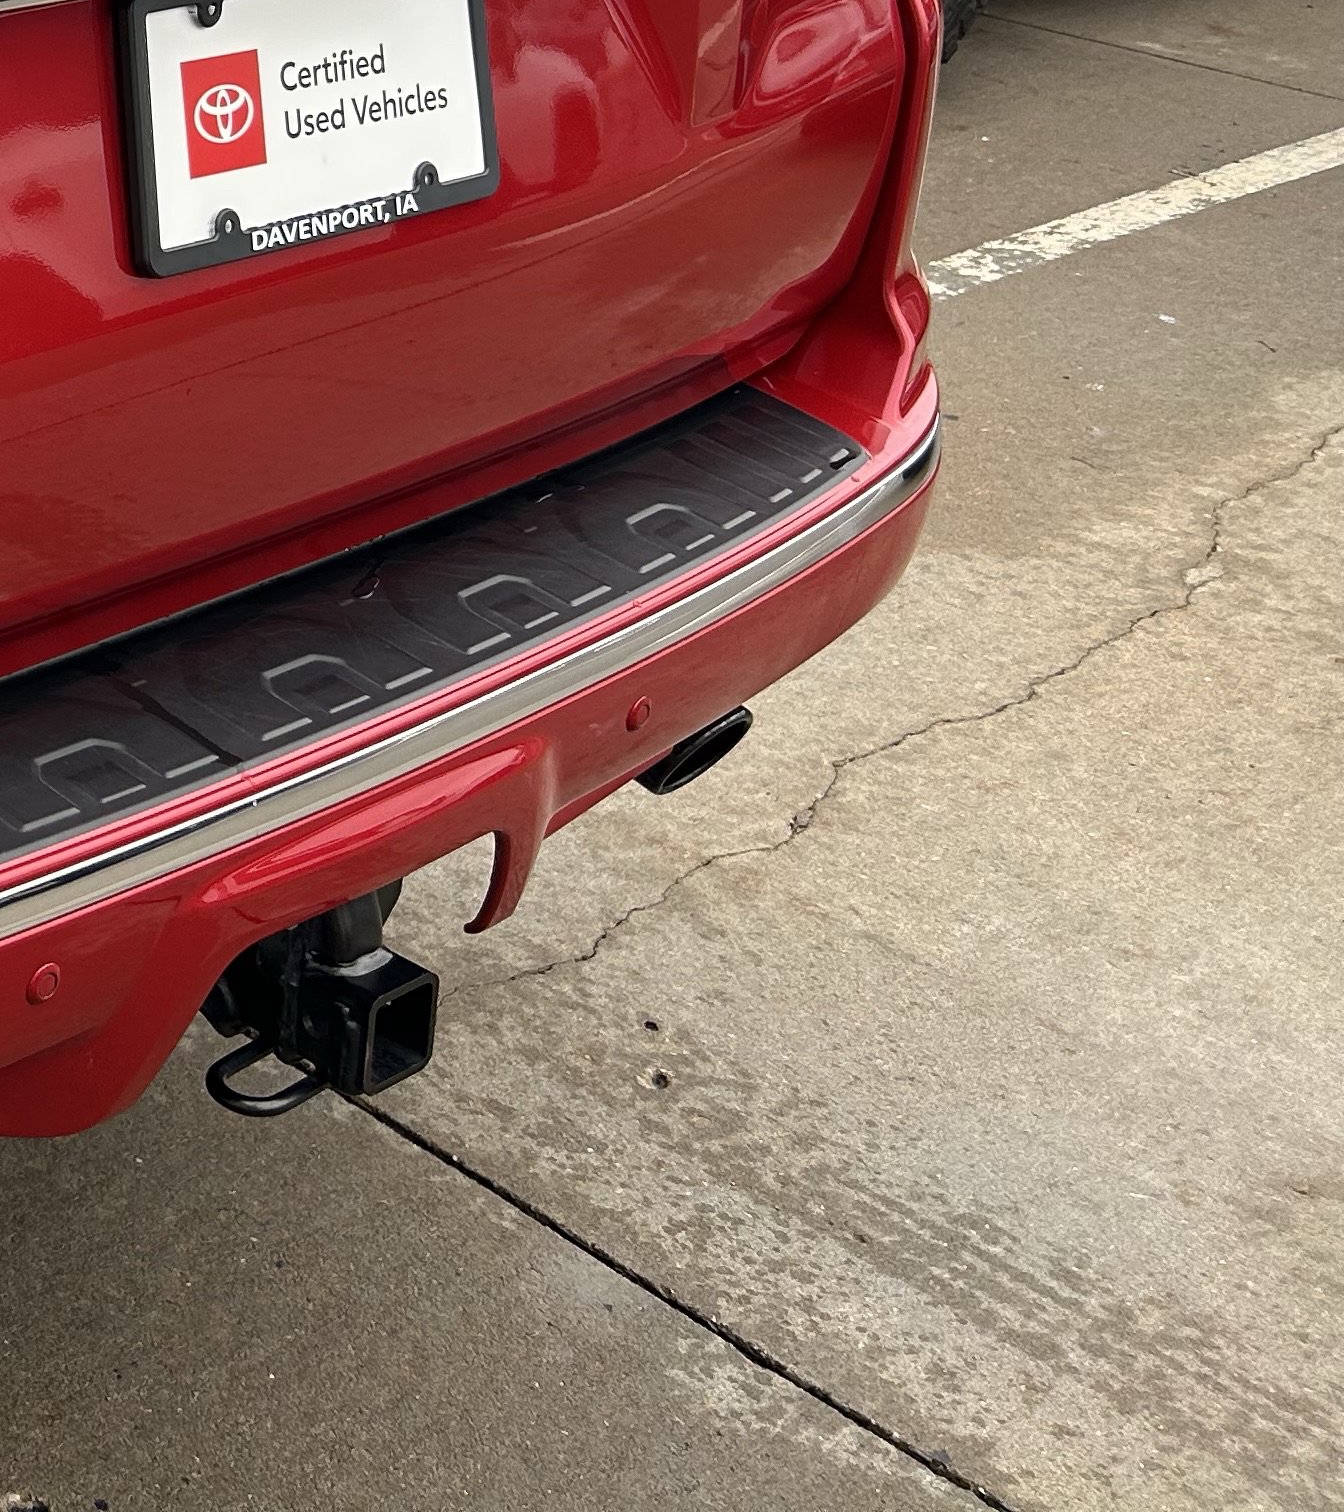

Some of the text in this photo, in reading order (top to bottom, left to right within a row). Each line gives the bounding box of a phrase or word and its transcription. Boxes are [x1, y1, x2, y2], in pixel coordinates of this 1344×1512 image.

[280, 43, 386, 91] Certified
[284, 83, 448, 139] Used Vehicles
[251, 194, 419, 251] DAVENPORT, IA
